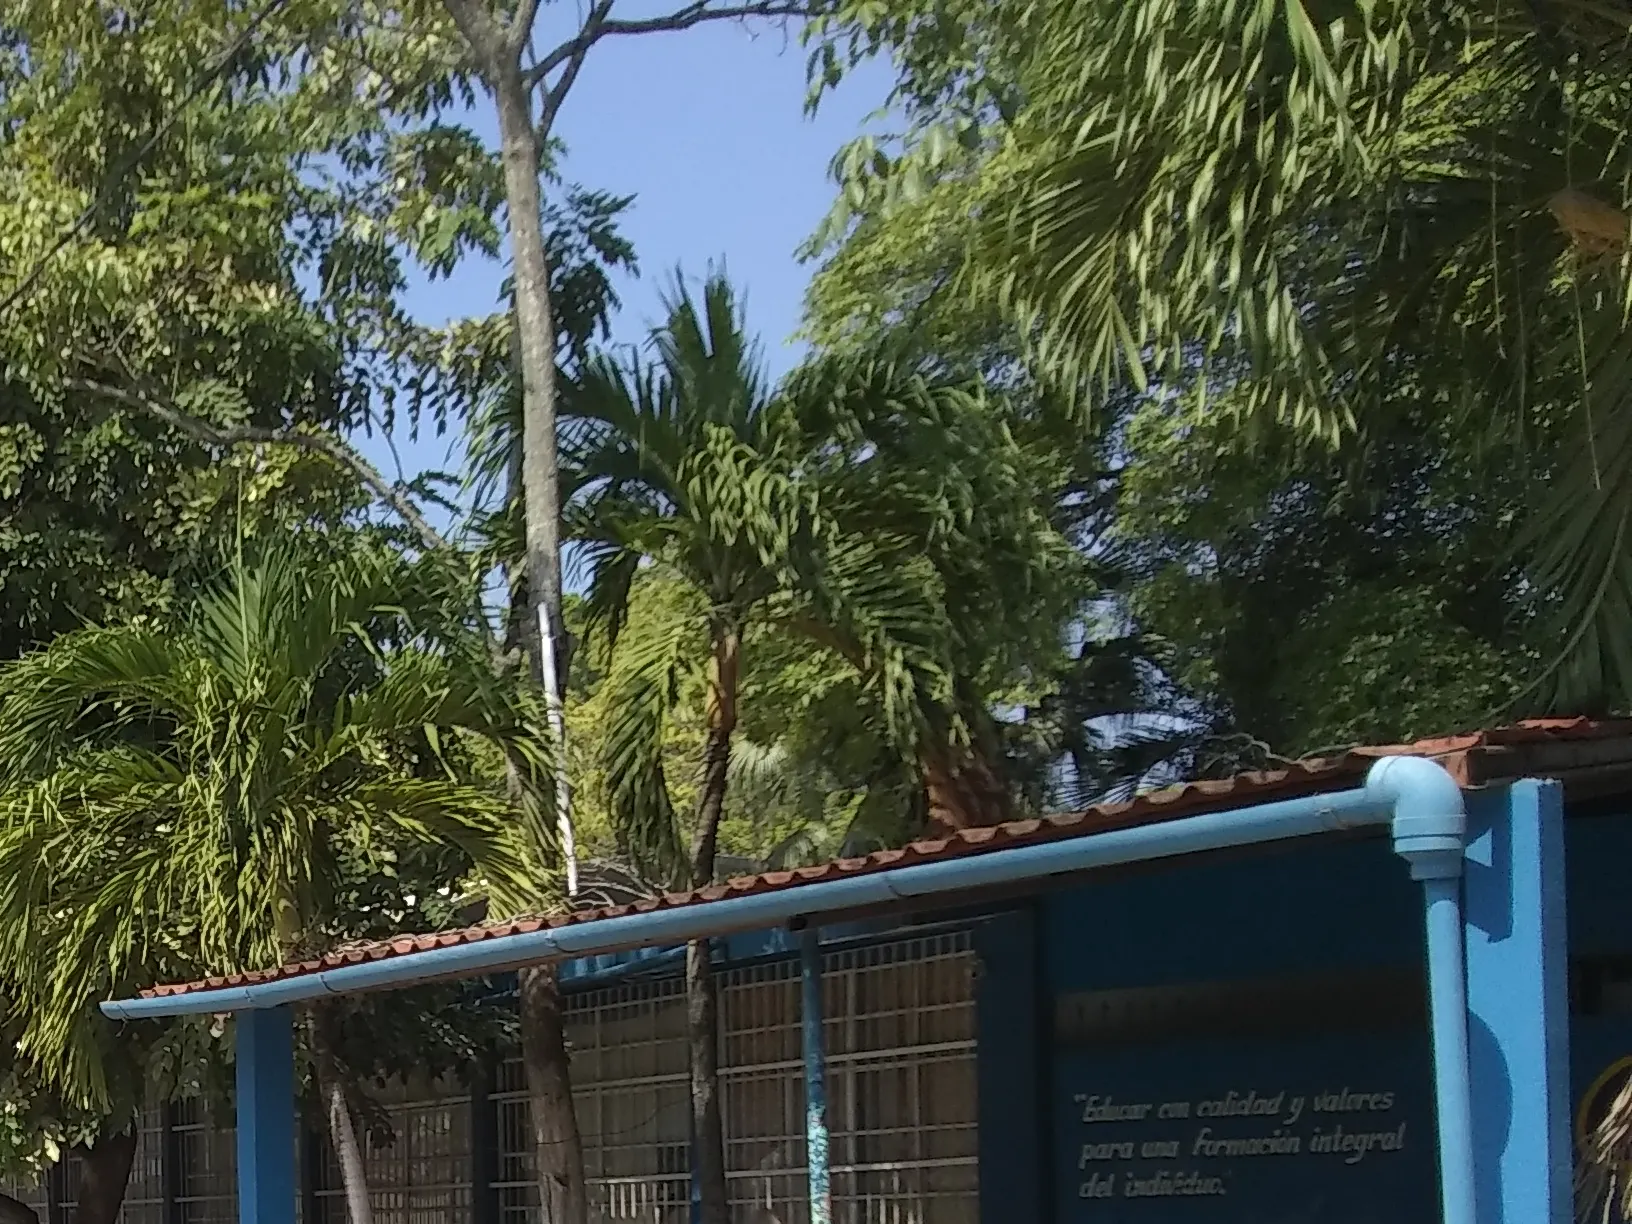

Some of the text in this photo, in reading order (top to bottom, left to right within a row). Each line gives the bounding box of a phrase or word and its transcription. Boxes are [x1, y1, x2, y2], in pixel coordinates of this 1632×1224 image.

[1157, 1101, 1190, 1120] con
[1196, 1090, 1286, 1117] calidad
[1283, 1096, 1305, 1126] y
[1312, 1086, 1396, 1113] valores
[1078, 1141, 1135, 1170] para
[1141, 1140, 1180, 1159] una
[1308, 1121, 1407, 1164] integral
[1078, 1172, 1115, 1199] del
